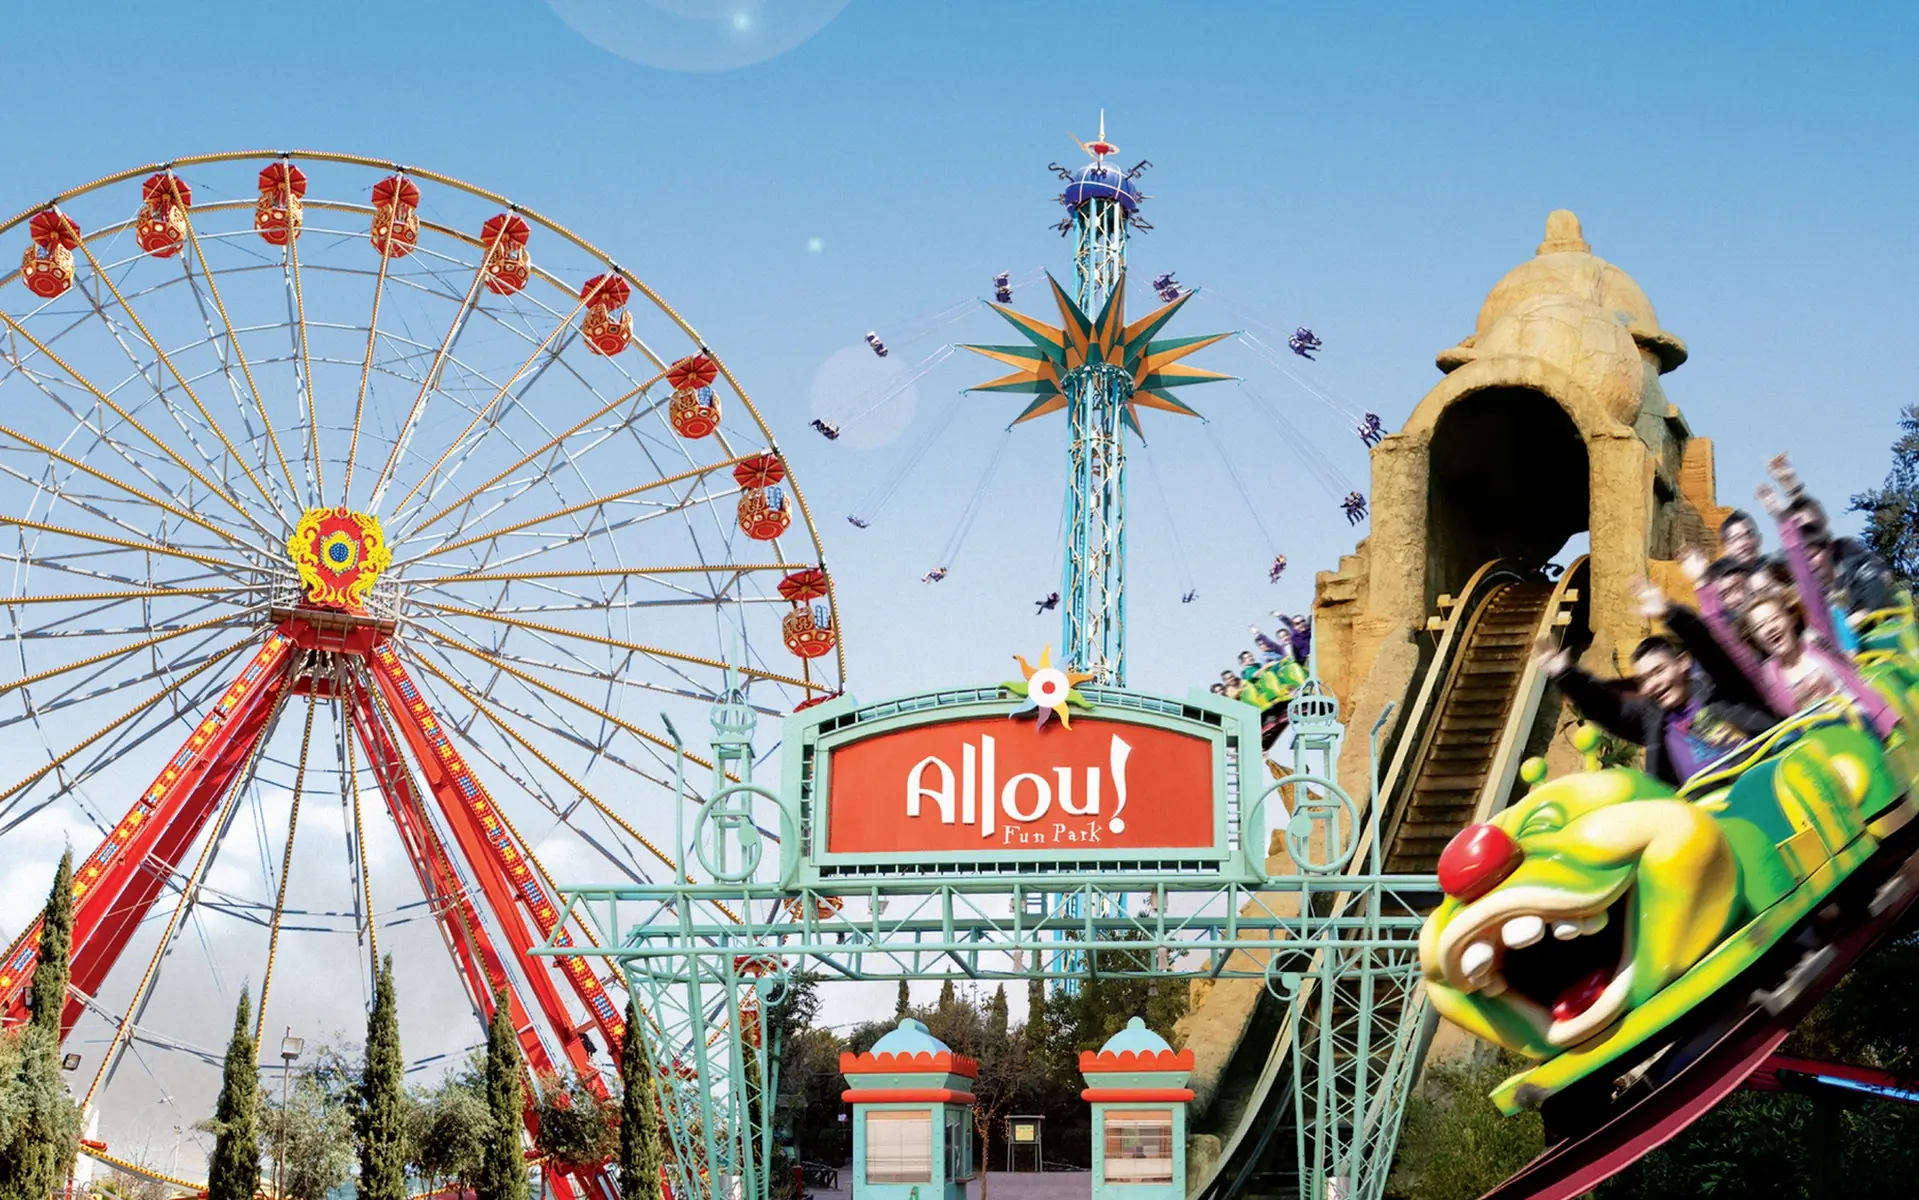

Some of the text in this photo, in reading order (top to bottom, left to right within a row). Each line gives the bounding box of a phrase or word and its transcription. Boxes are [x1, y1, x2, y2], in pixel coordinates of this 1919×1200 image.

[906, 733, 1132, 837] Allou!
[1003, 821, 1102, 845] Fun Park
